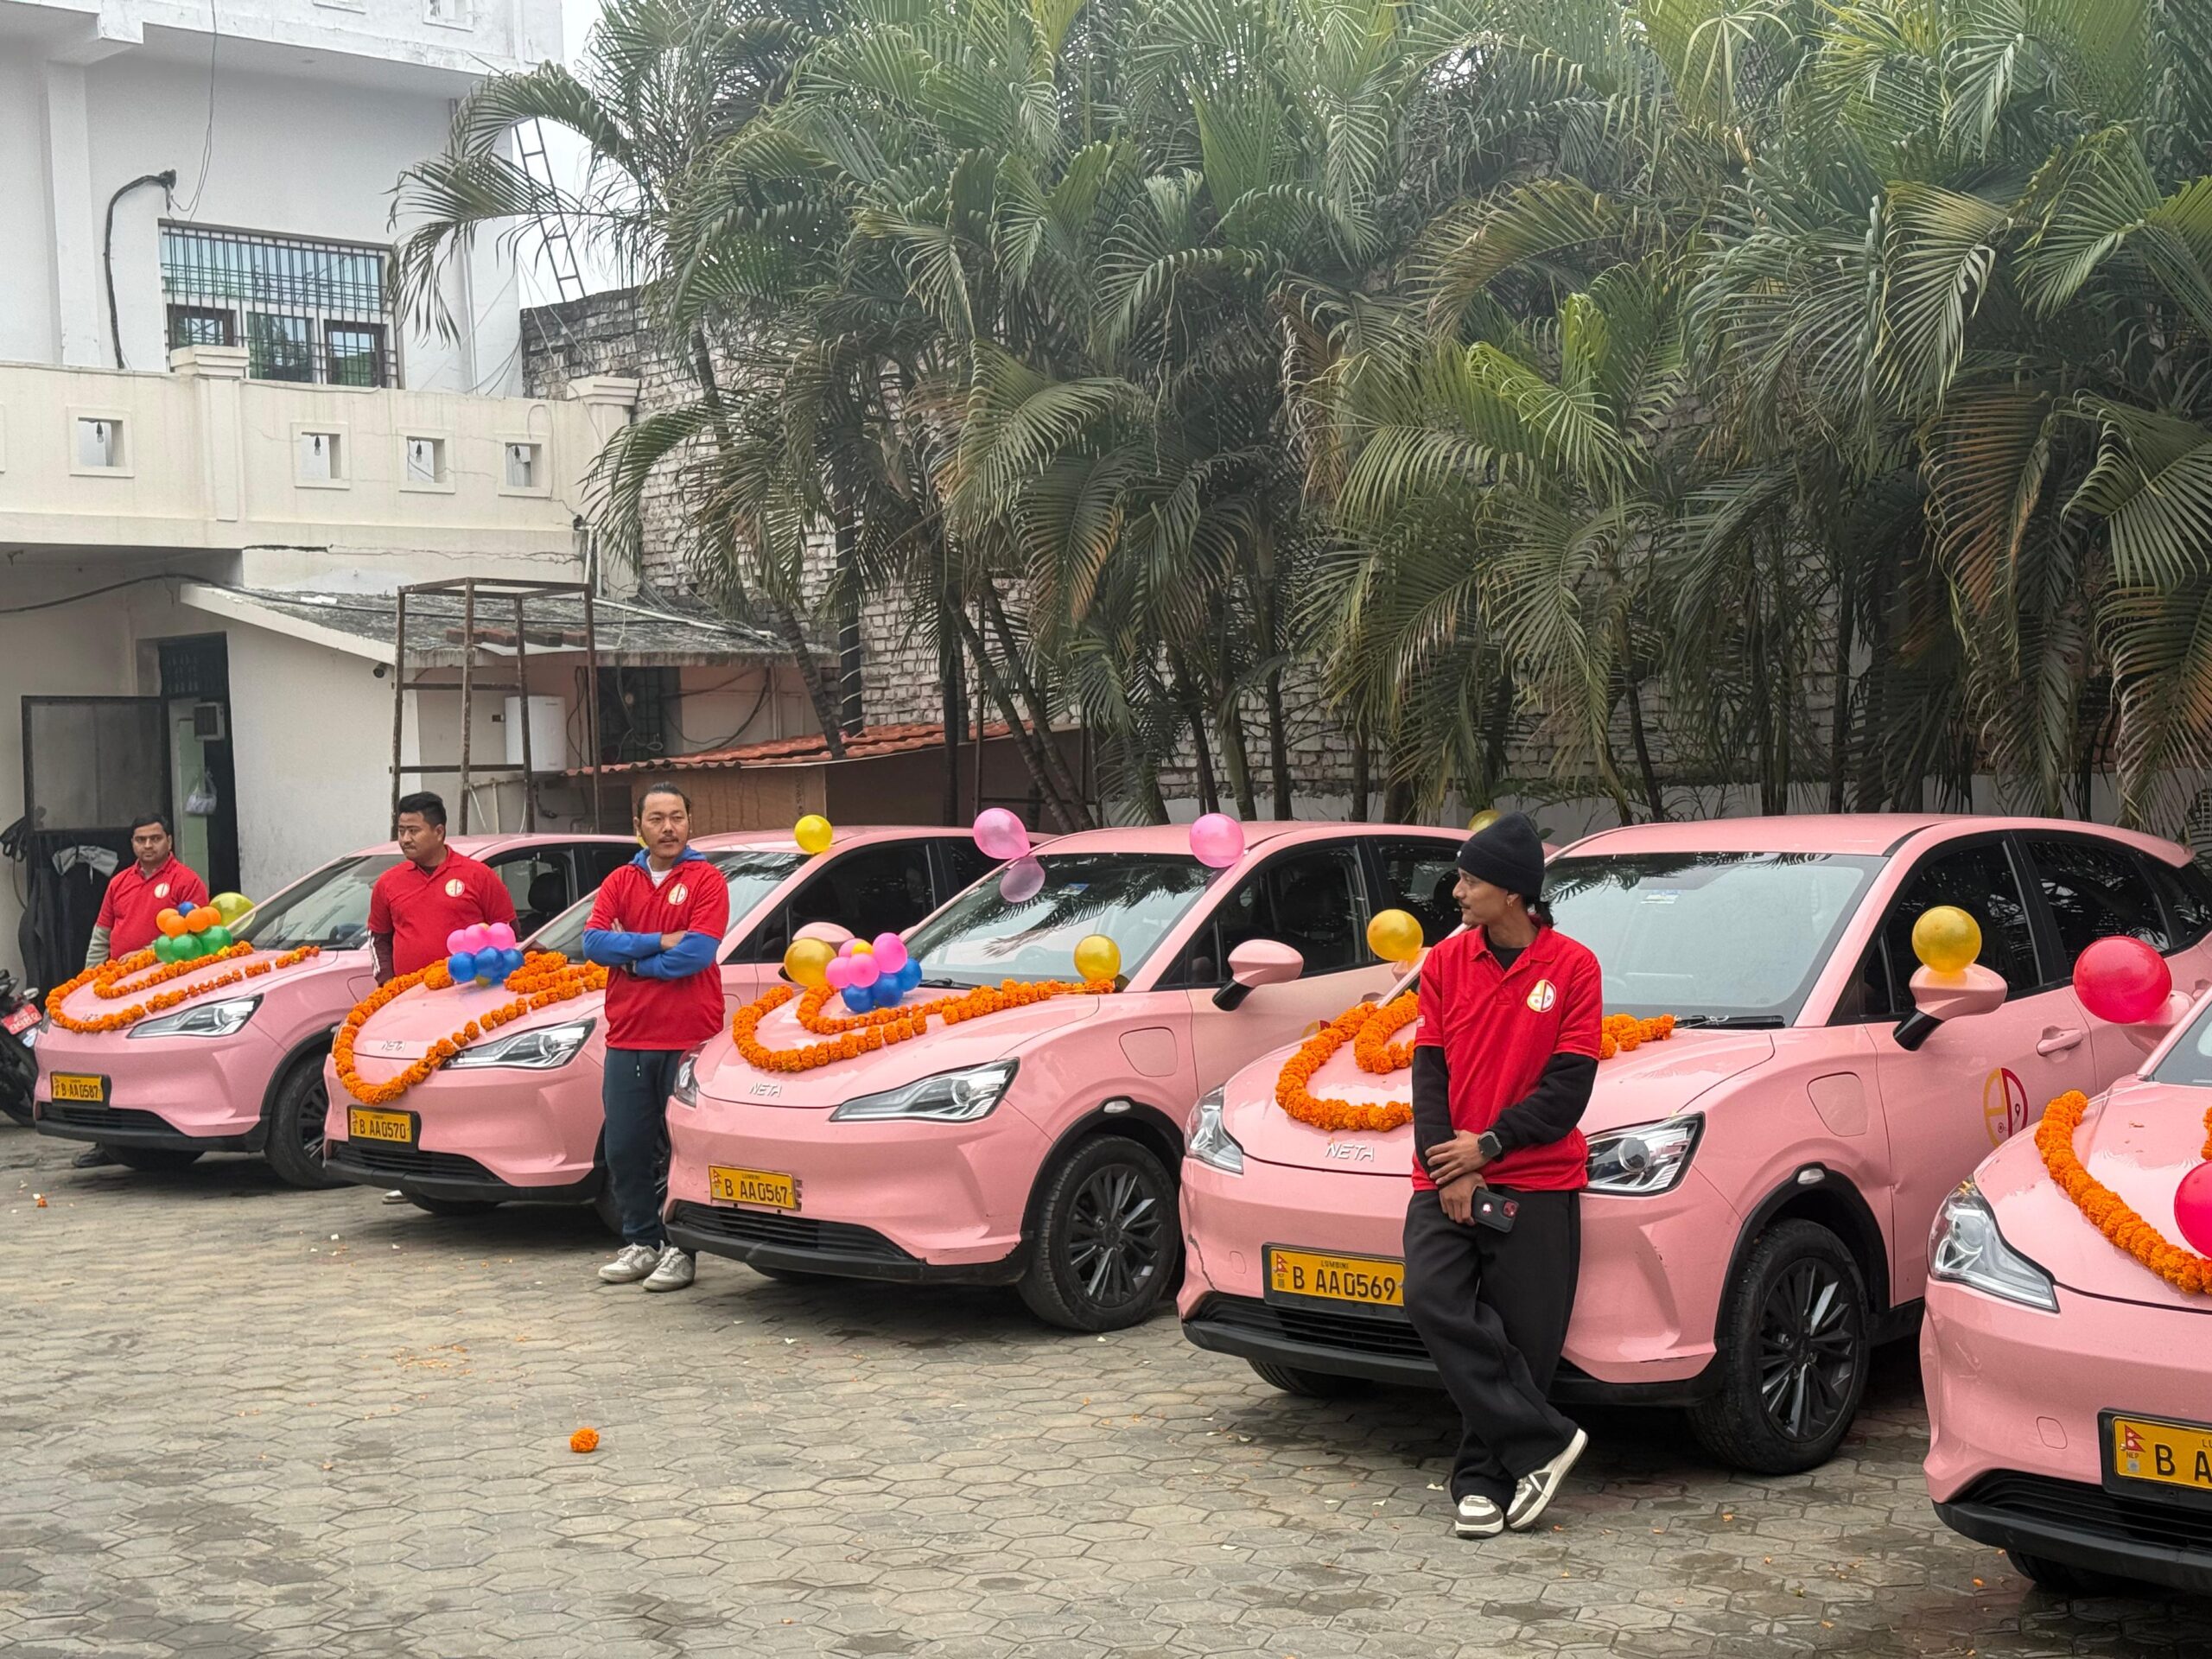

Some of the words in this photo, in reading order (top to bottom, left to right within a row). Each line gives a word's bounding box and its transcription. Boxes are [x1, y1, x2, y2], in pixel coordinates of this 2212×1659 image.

[60, 1083, 67, 1096] B
[69, 1084, 99, 1098] AA0587
[749, 1082, 783, 1098] NETA
[359, 1119, 365, 1135] B
[370, 1120, 406, 1139] AA0570
[1325, 1142, 1375, 1162] NETA
[724, 1178, 734, 1197] B
[740, 1180, 788, 1205] AA0567
[1293, 1266, 1305, 1289] B
[1315, 1268, 1396, 1300] AA0569
[2154, 1443, 2176, 1477] B
